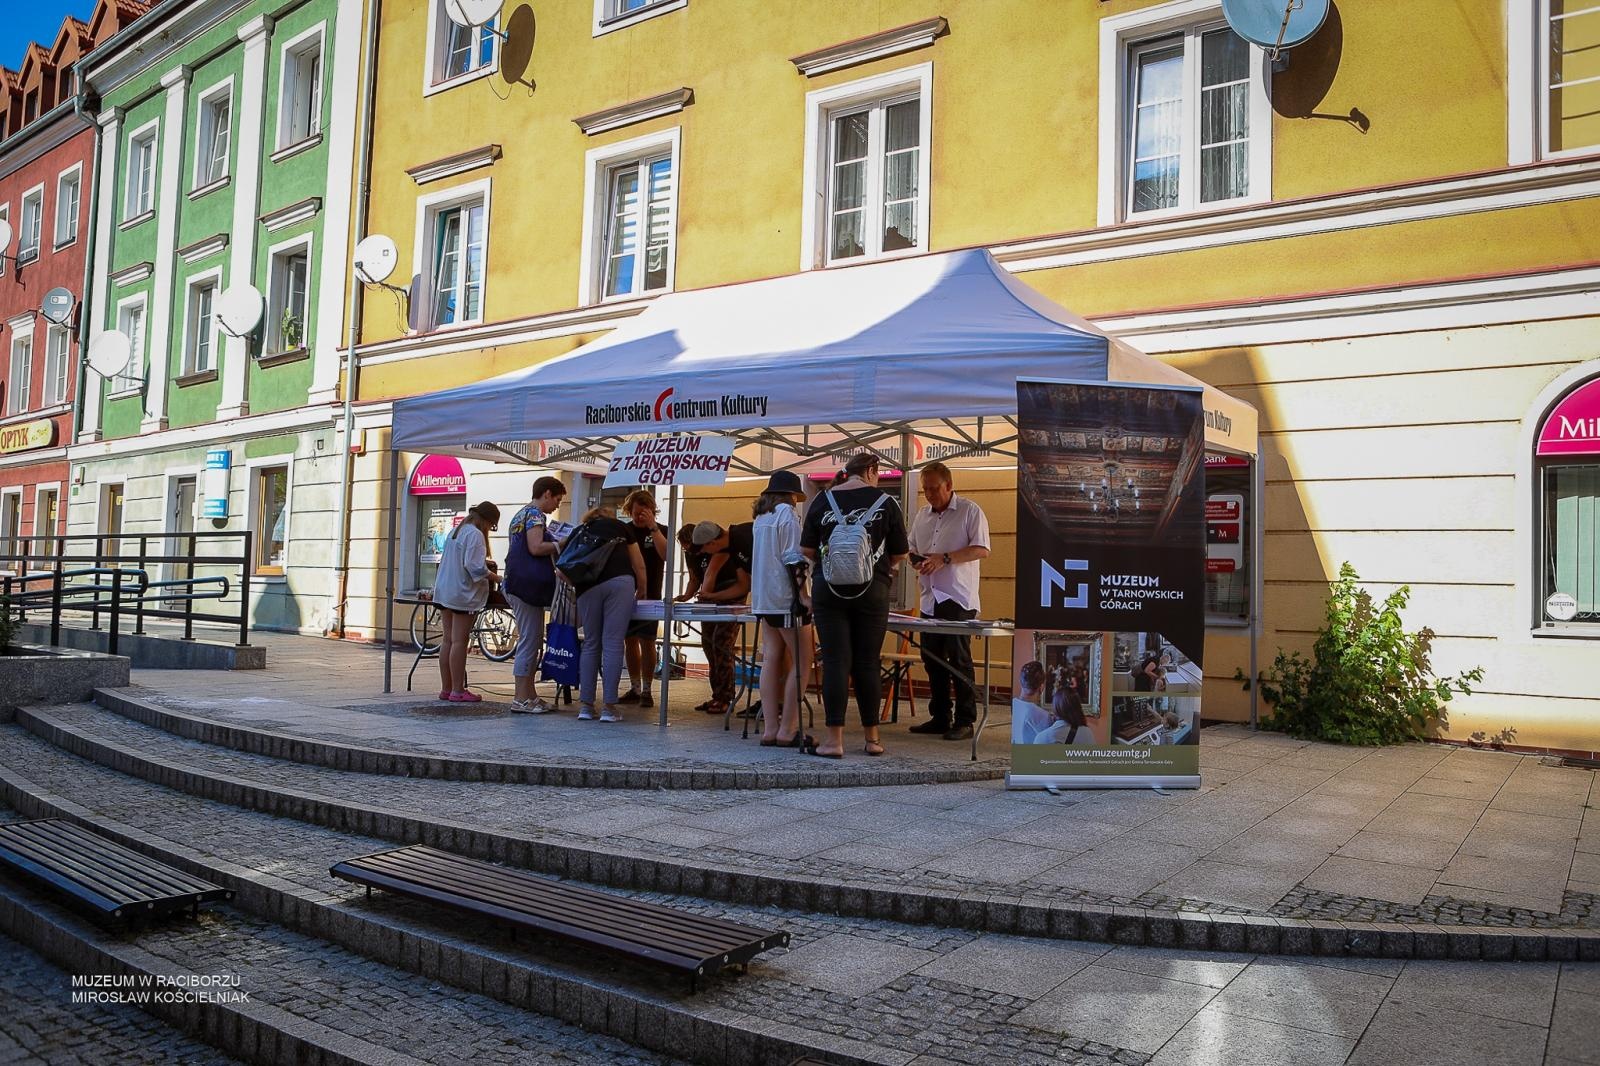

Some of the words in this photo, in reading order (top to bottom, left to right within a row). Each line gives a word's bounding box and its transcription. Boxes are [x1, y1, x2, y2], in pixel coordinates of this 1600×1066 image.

[586, 402, 651, 425] Raciborskie
[721, 394, 768, 417] Kultury
[0, 427, 29, 450] OPTYK
[634, 436, 702, 455] MUZEUM
[609, 457, 623, 472] Z
[623, 453, 731, 472] TARNOWSKICH
[416, 472, 464, 487] Millennium
[637, 466, 676, 485] GÓR
[1100, 574, 1160, 587] MUZEUM
[1100, 588, 1111, 598] W
[1112, 588, 1184, 600] TARNOWSKICH
[1100, 598, 1142, 610] GÓRACH
[1065, 747, 1151, 759] www.muzeumtg.pl
